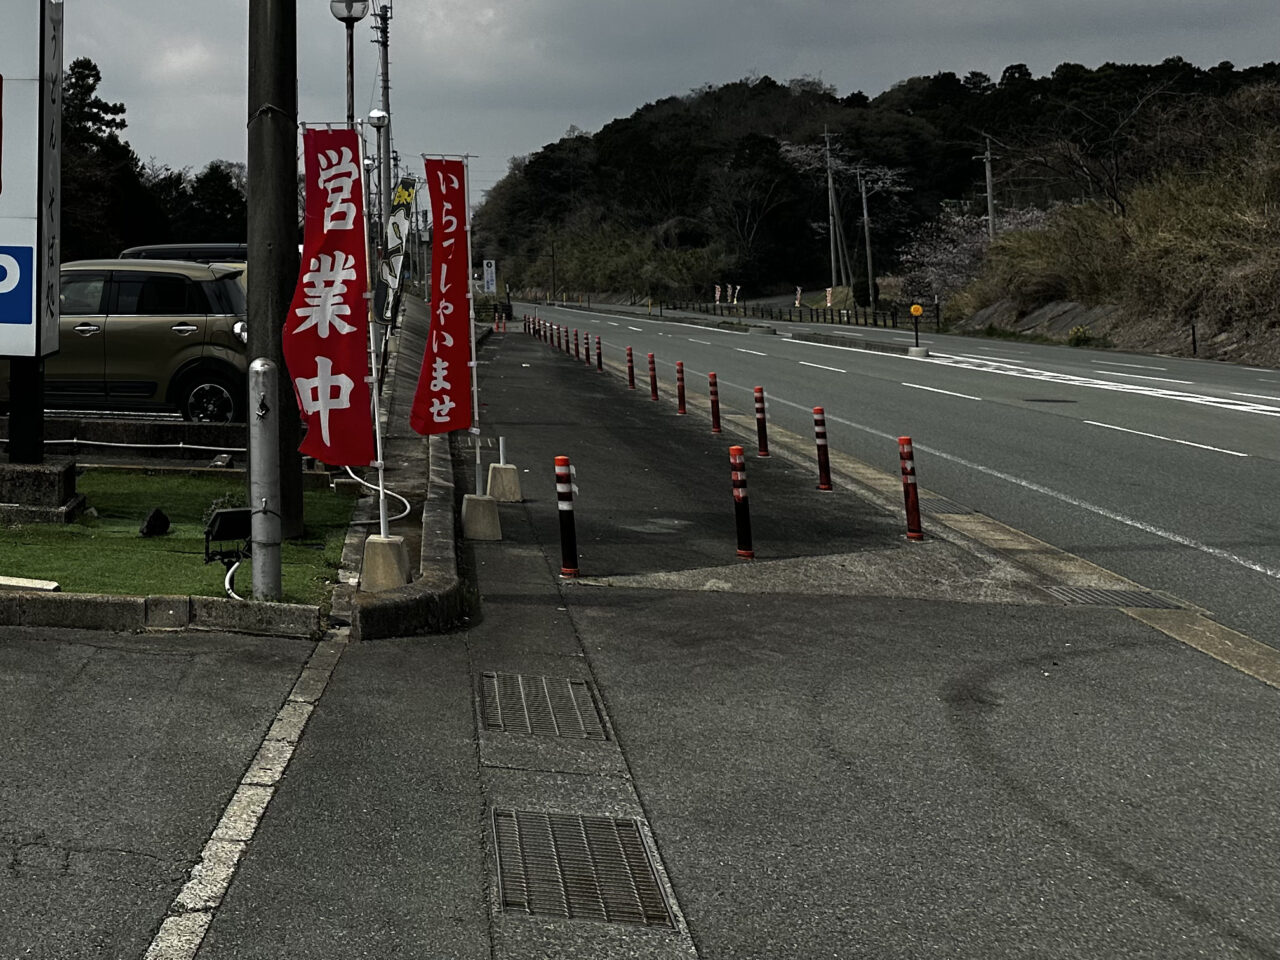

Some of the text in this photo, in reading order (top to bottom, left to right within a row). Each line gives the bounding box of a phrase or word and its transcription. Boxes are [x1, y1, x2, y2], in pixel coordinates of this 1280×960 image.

[292, 146, 360, 447] 営業中
[428, 170, 460, 423] いらっしゃいませ
